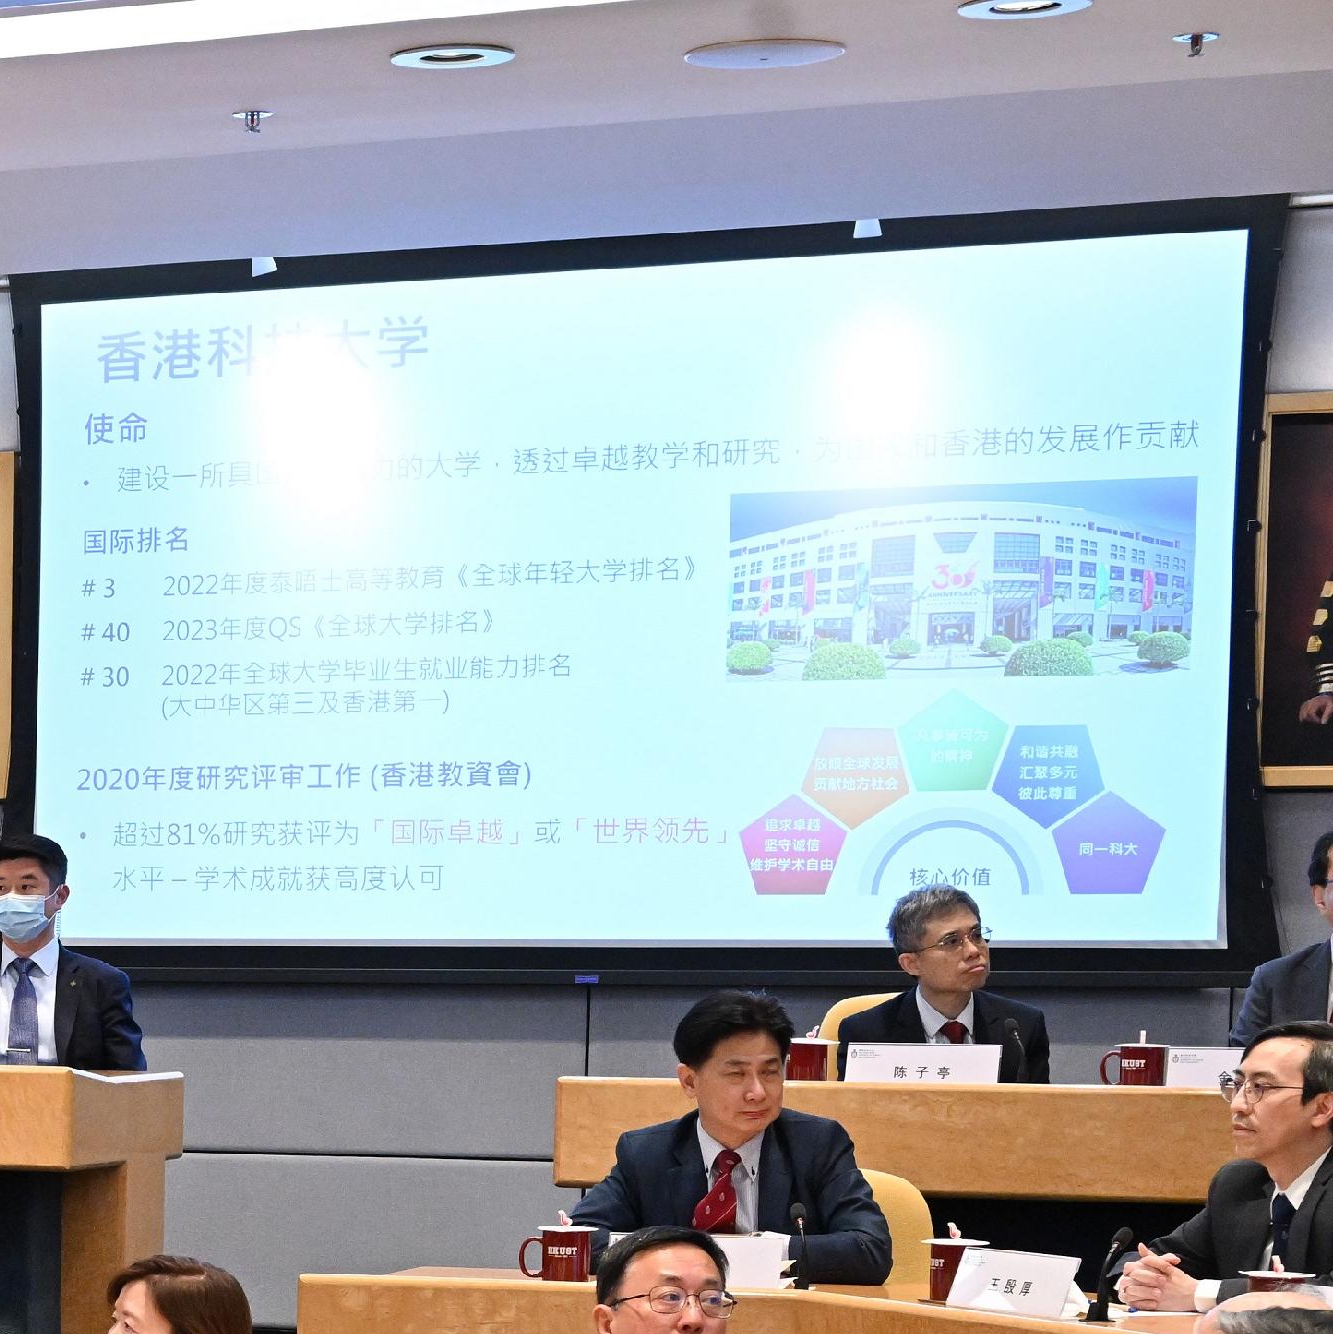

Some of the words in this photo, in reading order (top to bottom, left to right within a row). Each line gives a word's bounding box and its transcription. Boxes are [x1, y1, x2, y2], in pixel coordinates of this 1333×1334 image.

[96, 314, 430, 384] 香港科大学
[84, 412, 148, 445] 使命
[83, 525, 189, 555] 国际排名
[1020, 745, 1078, 759] 和谐共融
[1019, 766, 1078, 780] 汇聚多元
[813, 777, 898, 792] 贡献地方社会
[1018, 786, 1077, 801] 彼此尊重
[765, 819, 821, 832] 追求卓越
[764, 839, 821, 853] 坚守诚信
[1078, 842, 1138, 856] 同一科大
[750, 857, 834, 872] 维护学术自由
[910, 868, 991, 887] 核心价值
[893, 1066, 950, 1079] 陈子亭
[547, 1246, 578, 1255] HKUST
